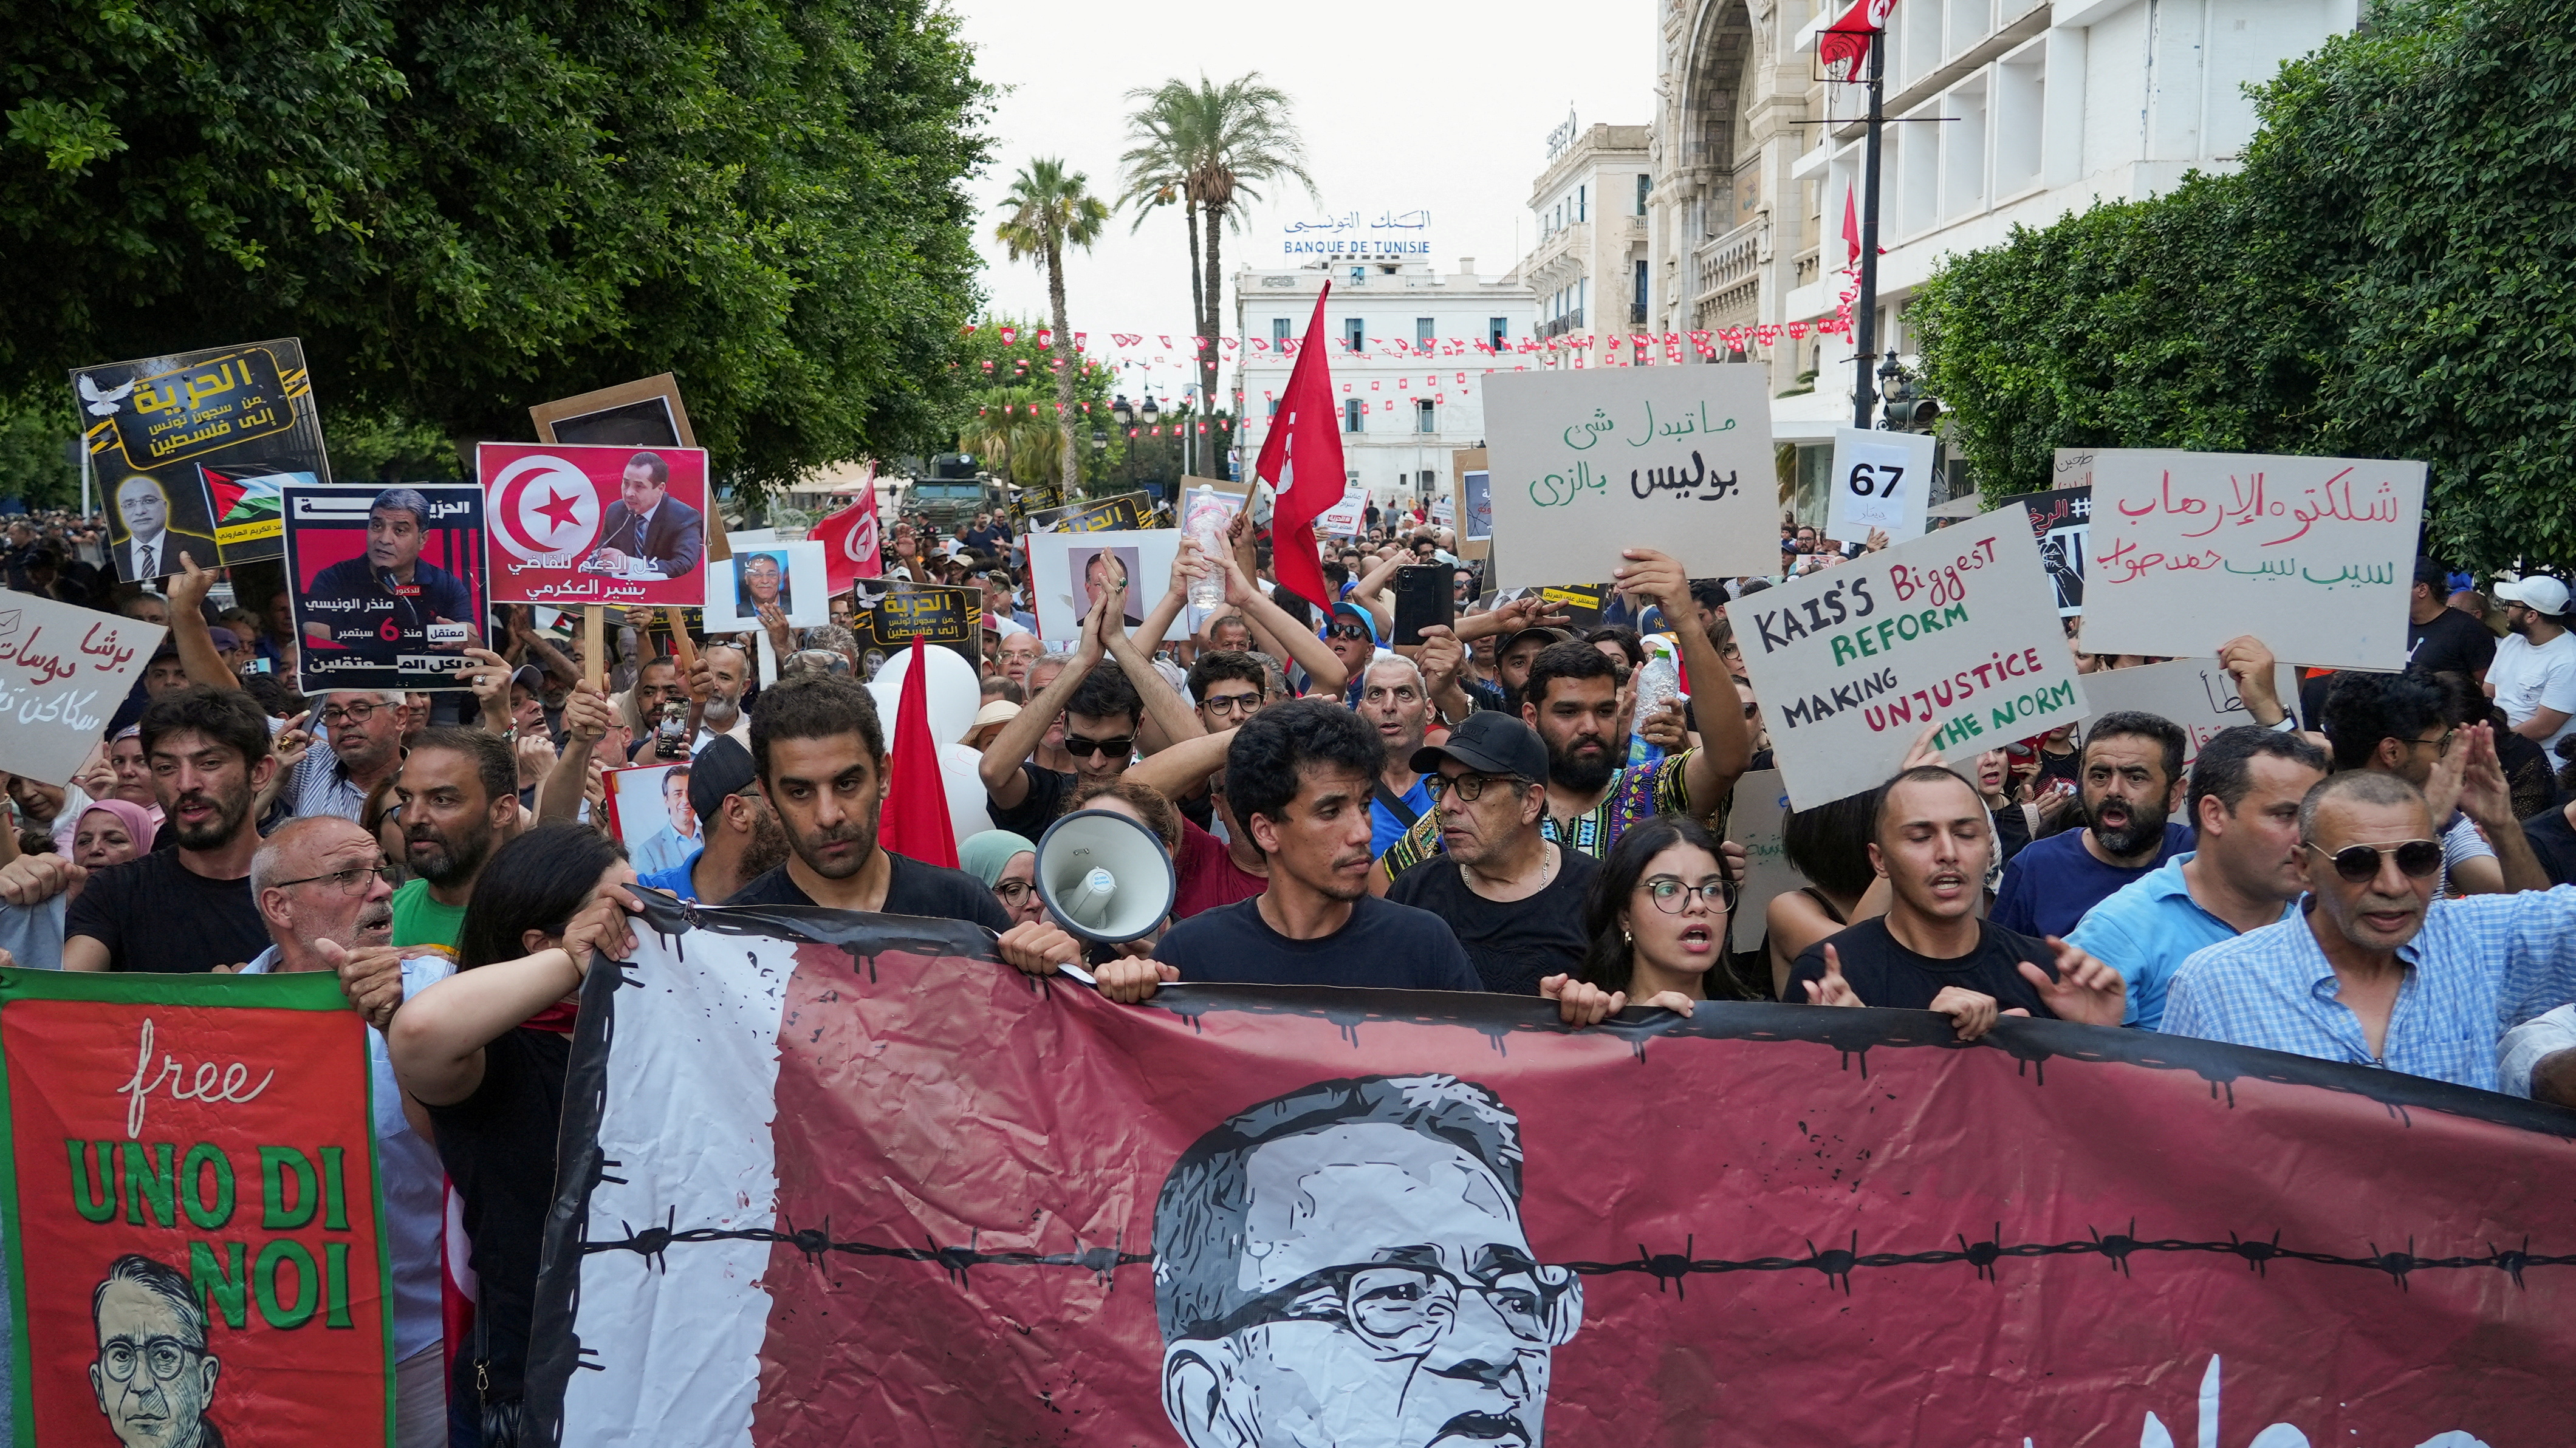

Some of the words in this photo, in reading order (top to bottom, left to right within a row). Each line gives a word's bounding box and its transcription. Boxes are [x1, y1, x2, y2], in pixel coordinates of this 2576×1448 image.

[1284, 211, 1359, 233] التونسي
[1371, 211, 1430, 229] البنك
[1285, 242, 1345, 253] BANQUE
[1351, 242, 1368, 253] DE
[1374, 242, 1430, 253] TUNISIE
[133, 358, 253, 415] الحرية
[241, 396, 262, 410] من
[148, 414, 188, 435] تونس
[191, 404, 232, 425] سجون
[238, 408, 276, 429] إلى
[149, 419, 231, 457] فلسطين
[1631, 450, 1739, 501] بوليس
[1850, 463, 1903, 498] 67
[2118, 469, 2264, 537] الإرهاب
[507, 553, 572, 576] للقاضي
[578, 555, 628, 573] الدعم
[632, 555, 659, 575] كل
[395, 587, 420, 595] للدكتور
[526, 578, 598, 600] العكرمي
[603, 579, 646, 599] بشير
[305, 598, 360, 613] الونيسي
[364, 599, 394, 613] منذر
[884, 594, 951, 616] الحرية
[1753, 576, 1875, 654] KAIS'S
[380, 617, 400, 642] 6
[889, 618, 911, 626] تونس
[942, 616, 954, 625] من
[337, 628, 374, 640] سبتمبر
[403, 628, 423, 638] منذ
[430, 629, 464, 639] معتقل
[888, 626, 933, 639] فلسطين
[938, 625, 959, 638] إلى
[1830, 602, 1969, 667] REFORM
[80, 622, 134, 673] برشا
[1781, 667, 1898, 728] MAKING
[1931, 712, 1984, 751] THE
[1992, 679, 2075, 730] NORM
[117, 1018, 275, 1139] free
[64, 1139, 236, 1231] UNO
[257, 1146, 352, 1232] DI
[188, 1239, 356, 1331] NOI
